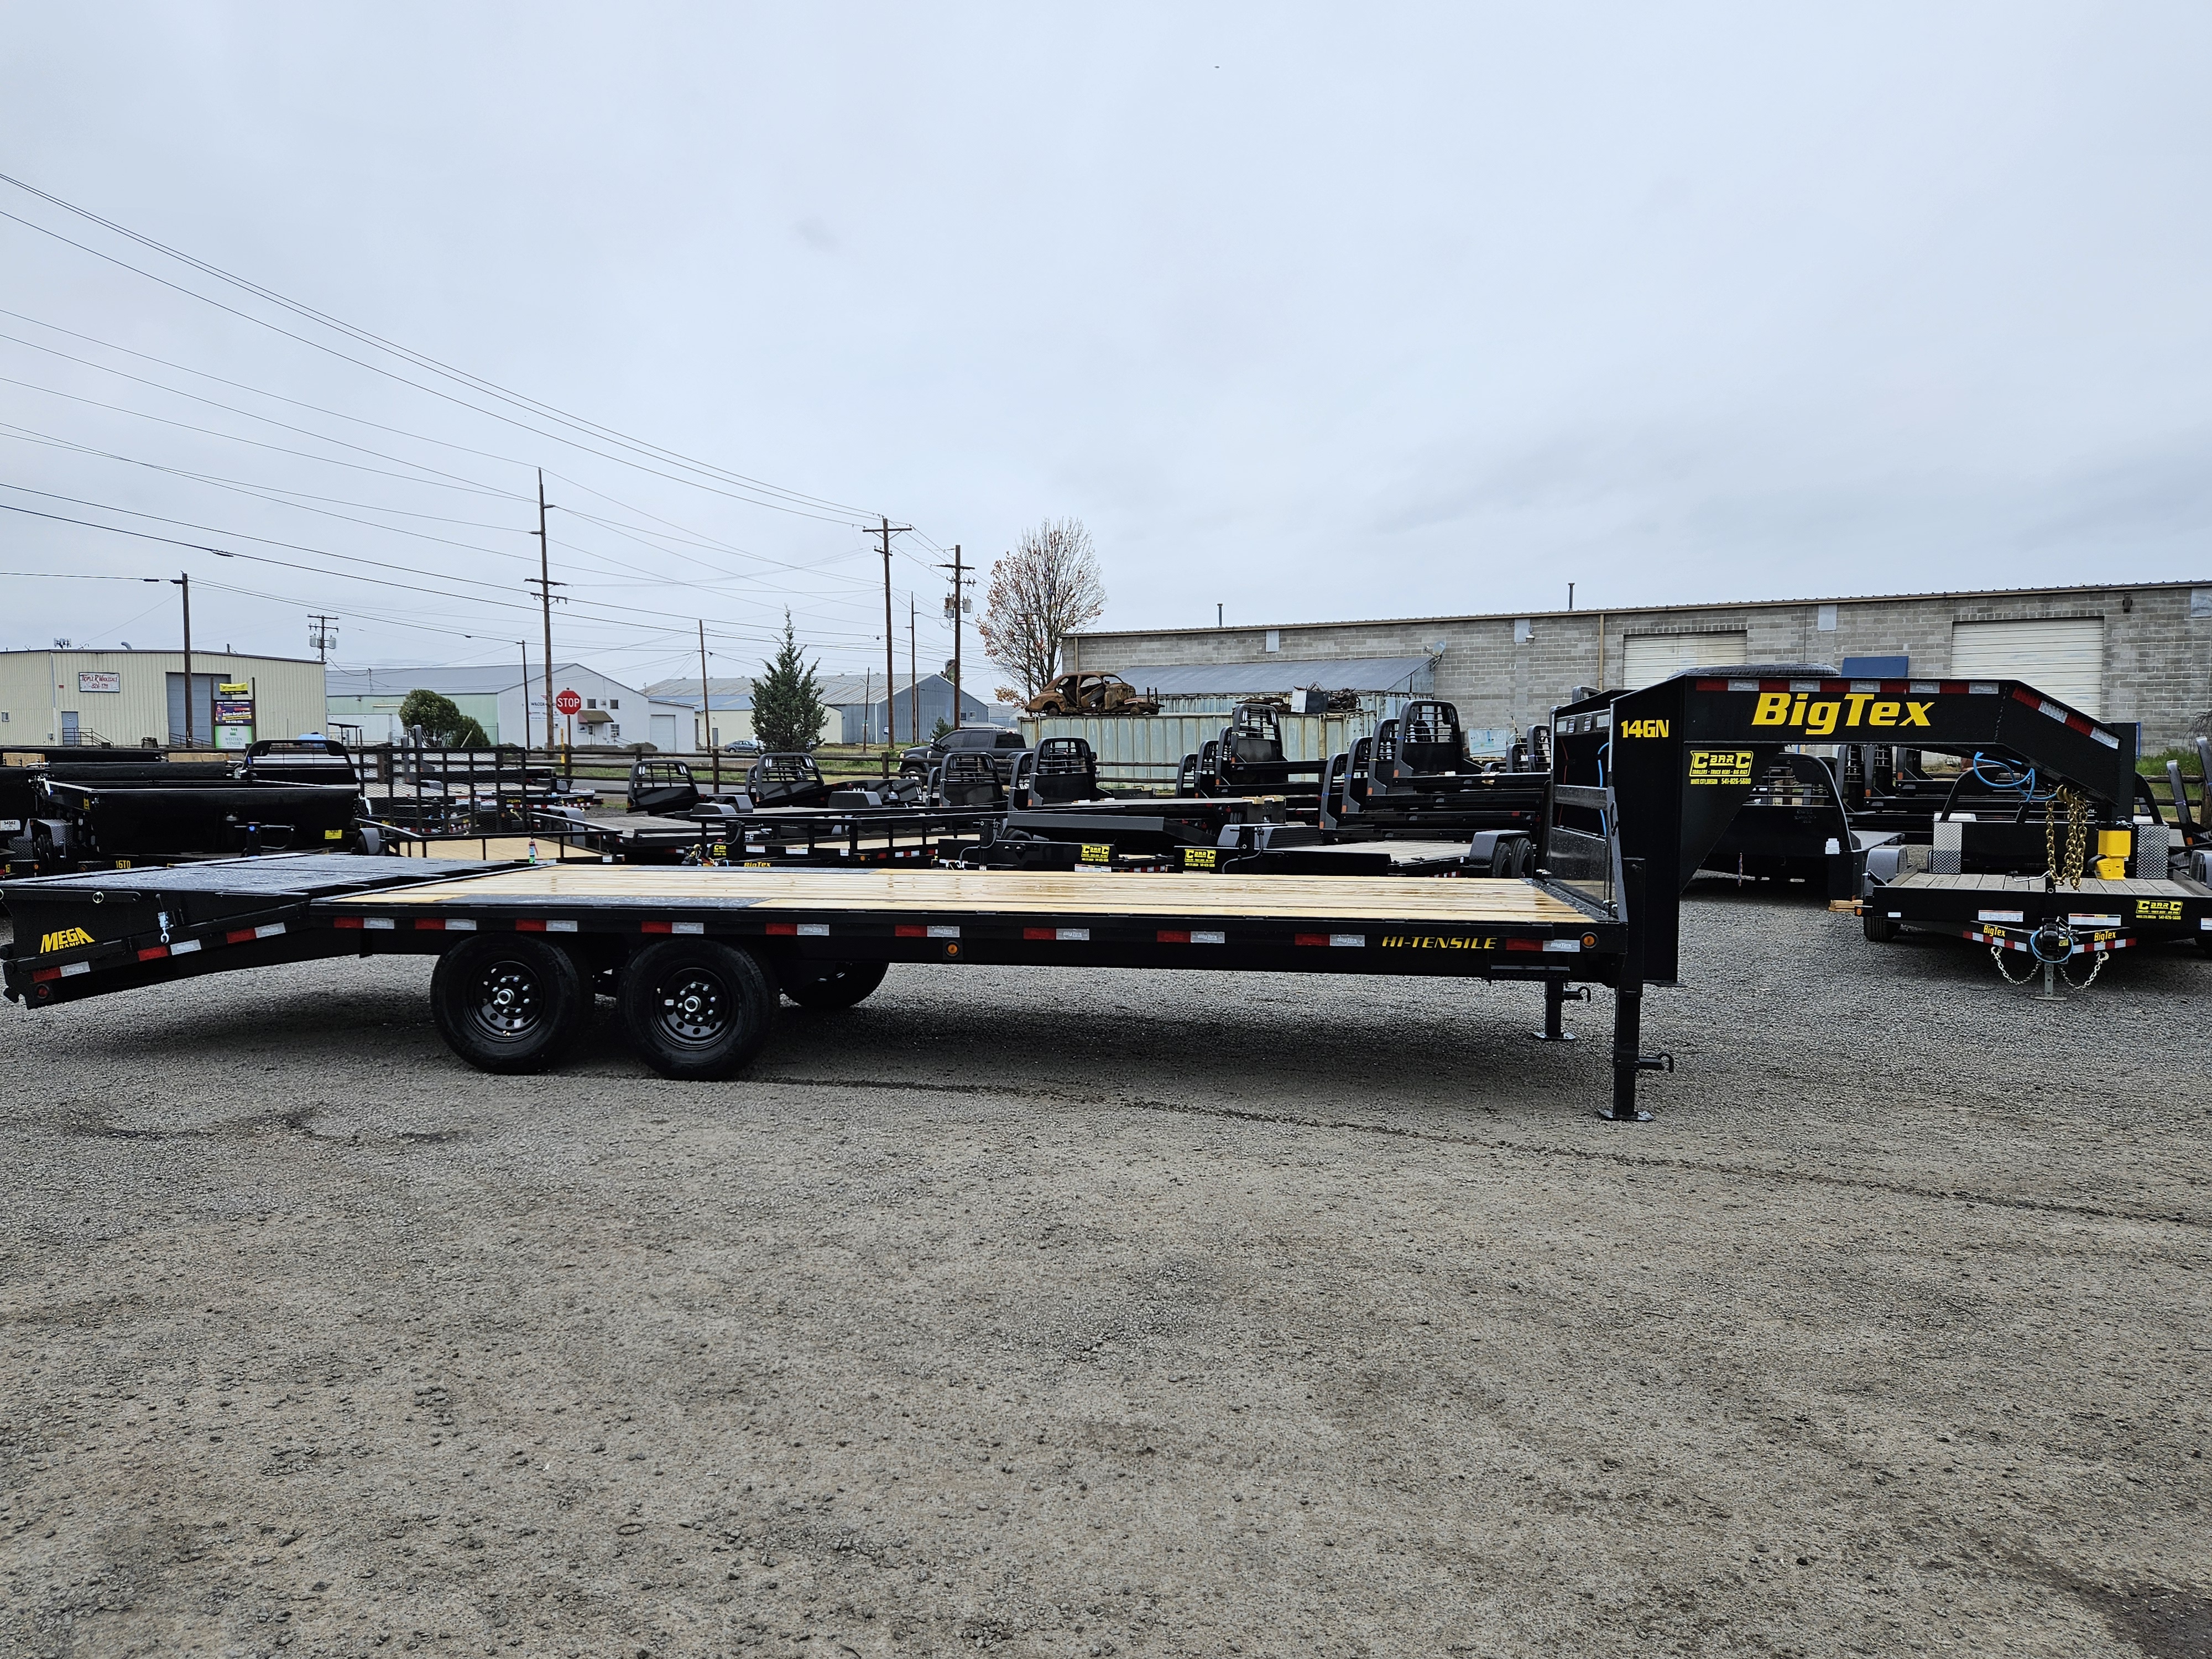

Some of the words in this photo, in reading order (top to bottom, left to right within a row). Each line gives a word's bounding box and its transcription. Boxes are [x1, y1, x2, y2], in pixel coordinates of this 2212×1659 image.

[95, 675, 100, 684] R
[557, 698, 580, 707] STOP
[1751, 692, 1935, 735] BigTex
[1621, 719, 1669, 738] 14GN
[1693, 753, 1709, 769] C
[1710, 755, 1734, 763] BAR
[1736, 753, 1751, 769] C
[2138, 900, 2150, 910] C
[2169, 901, 2182, 911] C
[1984, 925, 2006, 937] BigTex
[2094, 931, 2116, 943] BigTex
[40, 927, 95, 953] MEGA
[1383, 936, 1497, 948] HI-TENSILE
